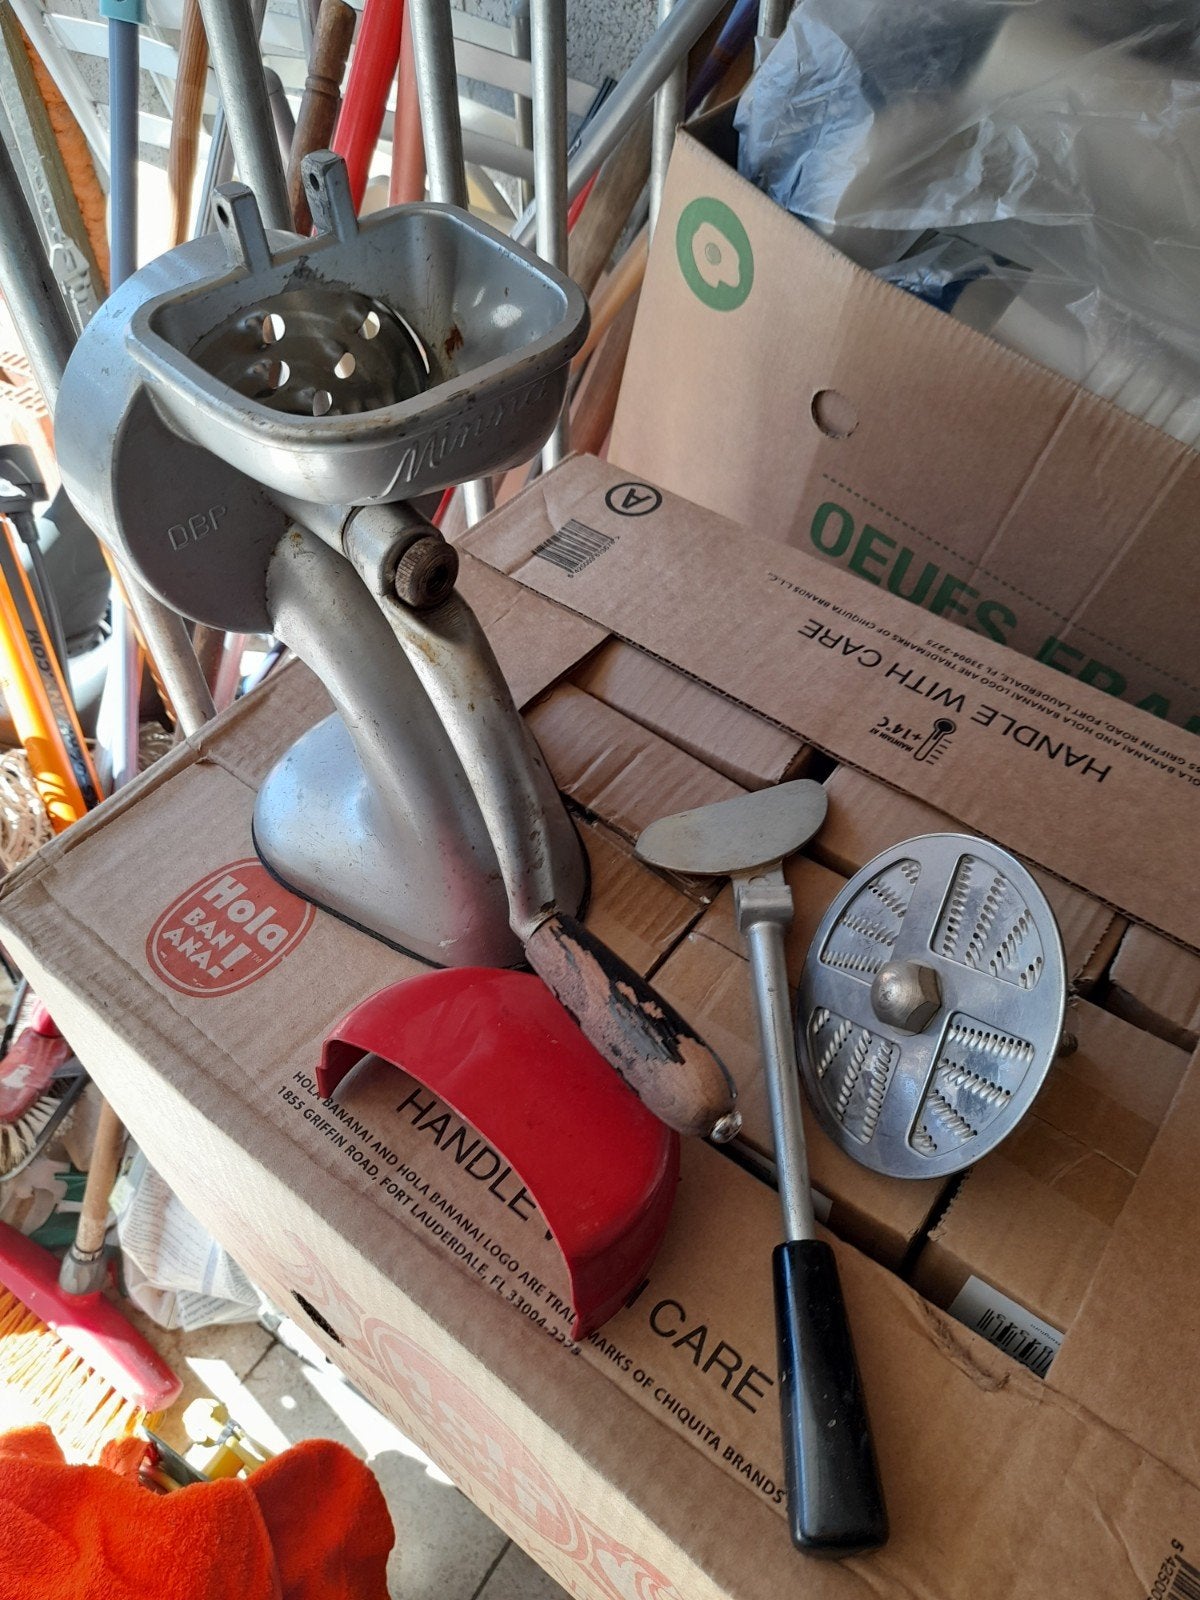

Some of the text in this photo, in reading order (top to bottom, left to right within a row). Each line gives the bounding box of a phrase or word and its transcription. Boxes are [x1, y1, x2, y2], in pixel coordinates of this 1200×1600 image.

[167, 504, 227, 551] DBP
[809, 502, 1018, 646] OEUFS
[793, 586, 832, 608] BRANDS
[832, 605, 876, 629] CHIQUITA
[877, 628, 891, 637] OF
[893, 634, 957, 671] TRADEMARKS
[958, 668, 981, 680] ARE
[980, 677, 1010, 695] LOGO
[985, 666, 999, 677] FL
[797, 618, 1113, 783] HANDLE WITH CARE
[1001, 673, 1072, 711] LAUDERDALE,
[1063, 716, 1094, 735] HOLA
[1072, 709, 1102, 726] FORT
[1104, 722, 1139, 743] ROAD,
[1095, 732, 1121, 747] AND
[1140, 741, 1186, 765] GRIFFIN
[202, 874, 289, 952] Hola
[182, 906, 236, 951] BAN
[396, 1087, 537, 1222] HANDLE
[277, 1085, 306, 1111] 1855
[303, 1108, 348, 1148] GRIFFIN
[344, 1144, 379, 1181] ROAD,
[379, 1177, 414, 1206] FORT
[410, 1203, 489, 1280] LAUDERDALE,
[490, 1274, 507, 1295] FL
[292, 1071, 322, 1101] HOLA
[370, 1141, 398, 1165] AND
[396, 1163, 430, 1196] HOLA
[483, 1238, 520, 1272] LOGO
[517, 1270, 547, 1297] ARE
[544, 1291, 633, 1372] TRAMARKS
[632, 1367, 655, 1389] OF
[653, 1387, 722, 1452] CHIQUITA
[722, 1446, 786, 1505] BRANDS
[649, 1298, 774, 1414] CARE
